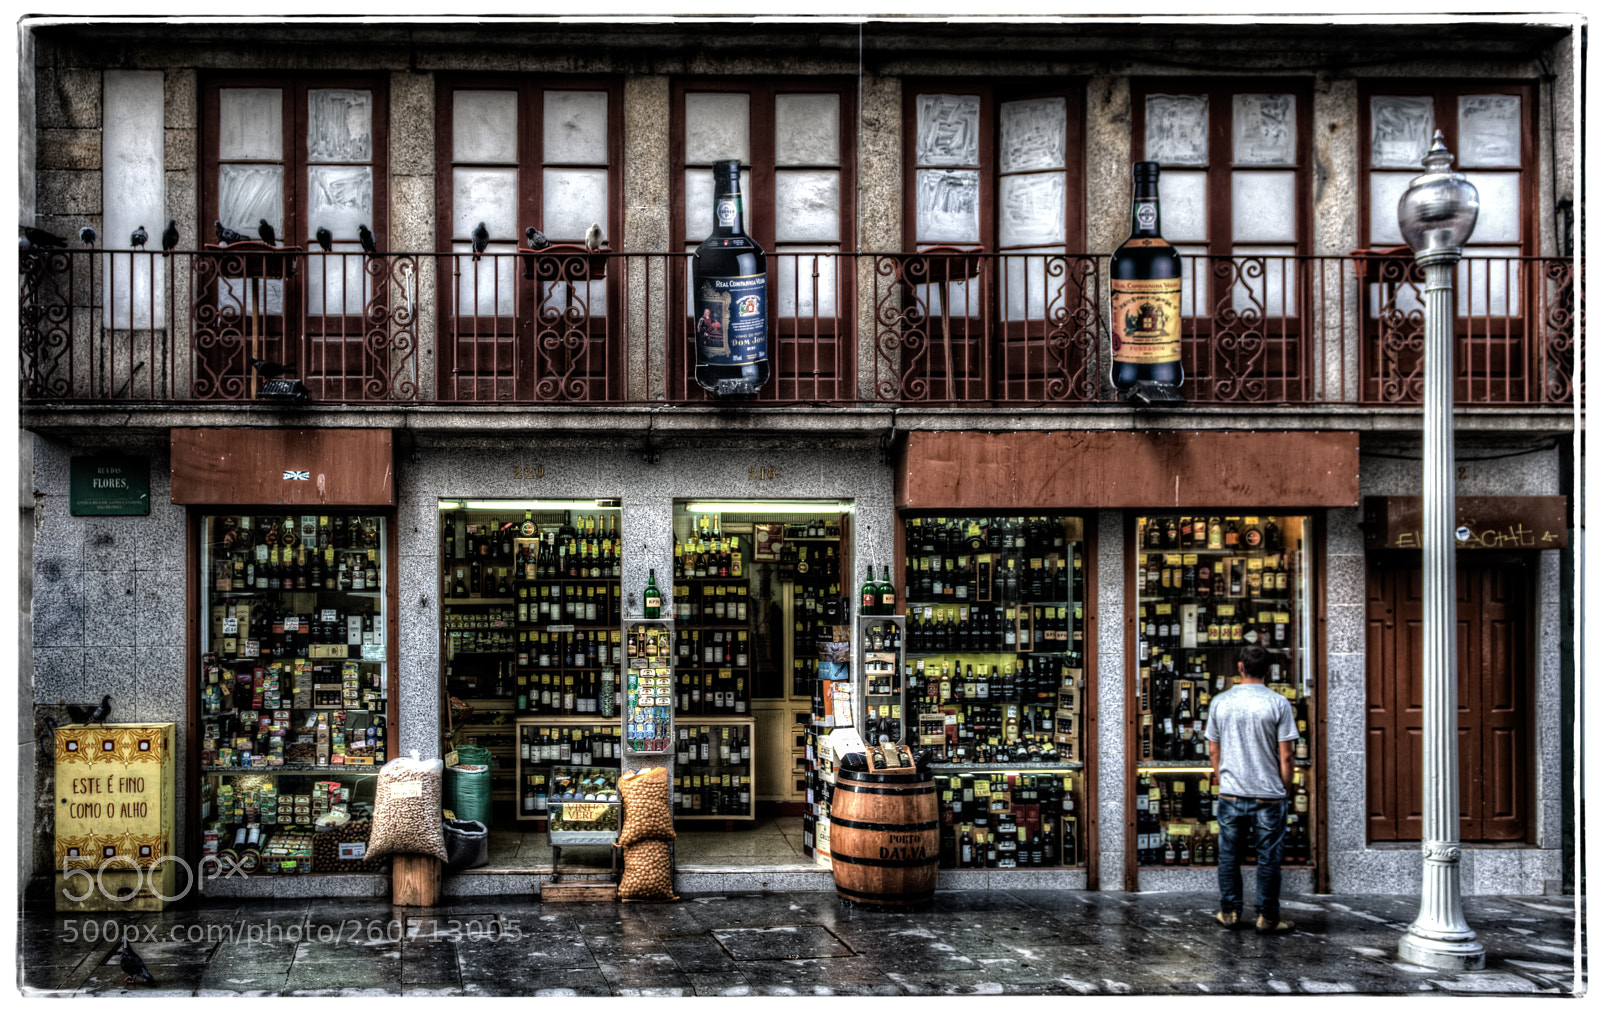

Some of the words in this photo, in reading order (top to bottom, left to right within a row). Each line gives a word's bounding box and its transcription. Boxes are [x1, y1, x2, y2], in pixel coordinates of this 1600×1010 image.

[512, 464, 545, 479] 220
[748, 465, 777, 480] 218
[72, 777, 101, 794] ESTE
[107, 774, 114, 794] É
[119, 777, 145, 794] FINO
[70, 802, 101, 819] COMO
[107, 802, 115, 819] O
[120, 802, 148, 819] ALHO
[889, 834, 920, 844] PORTO
